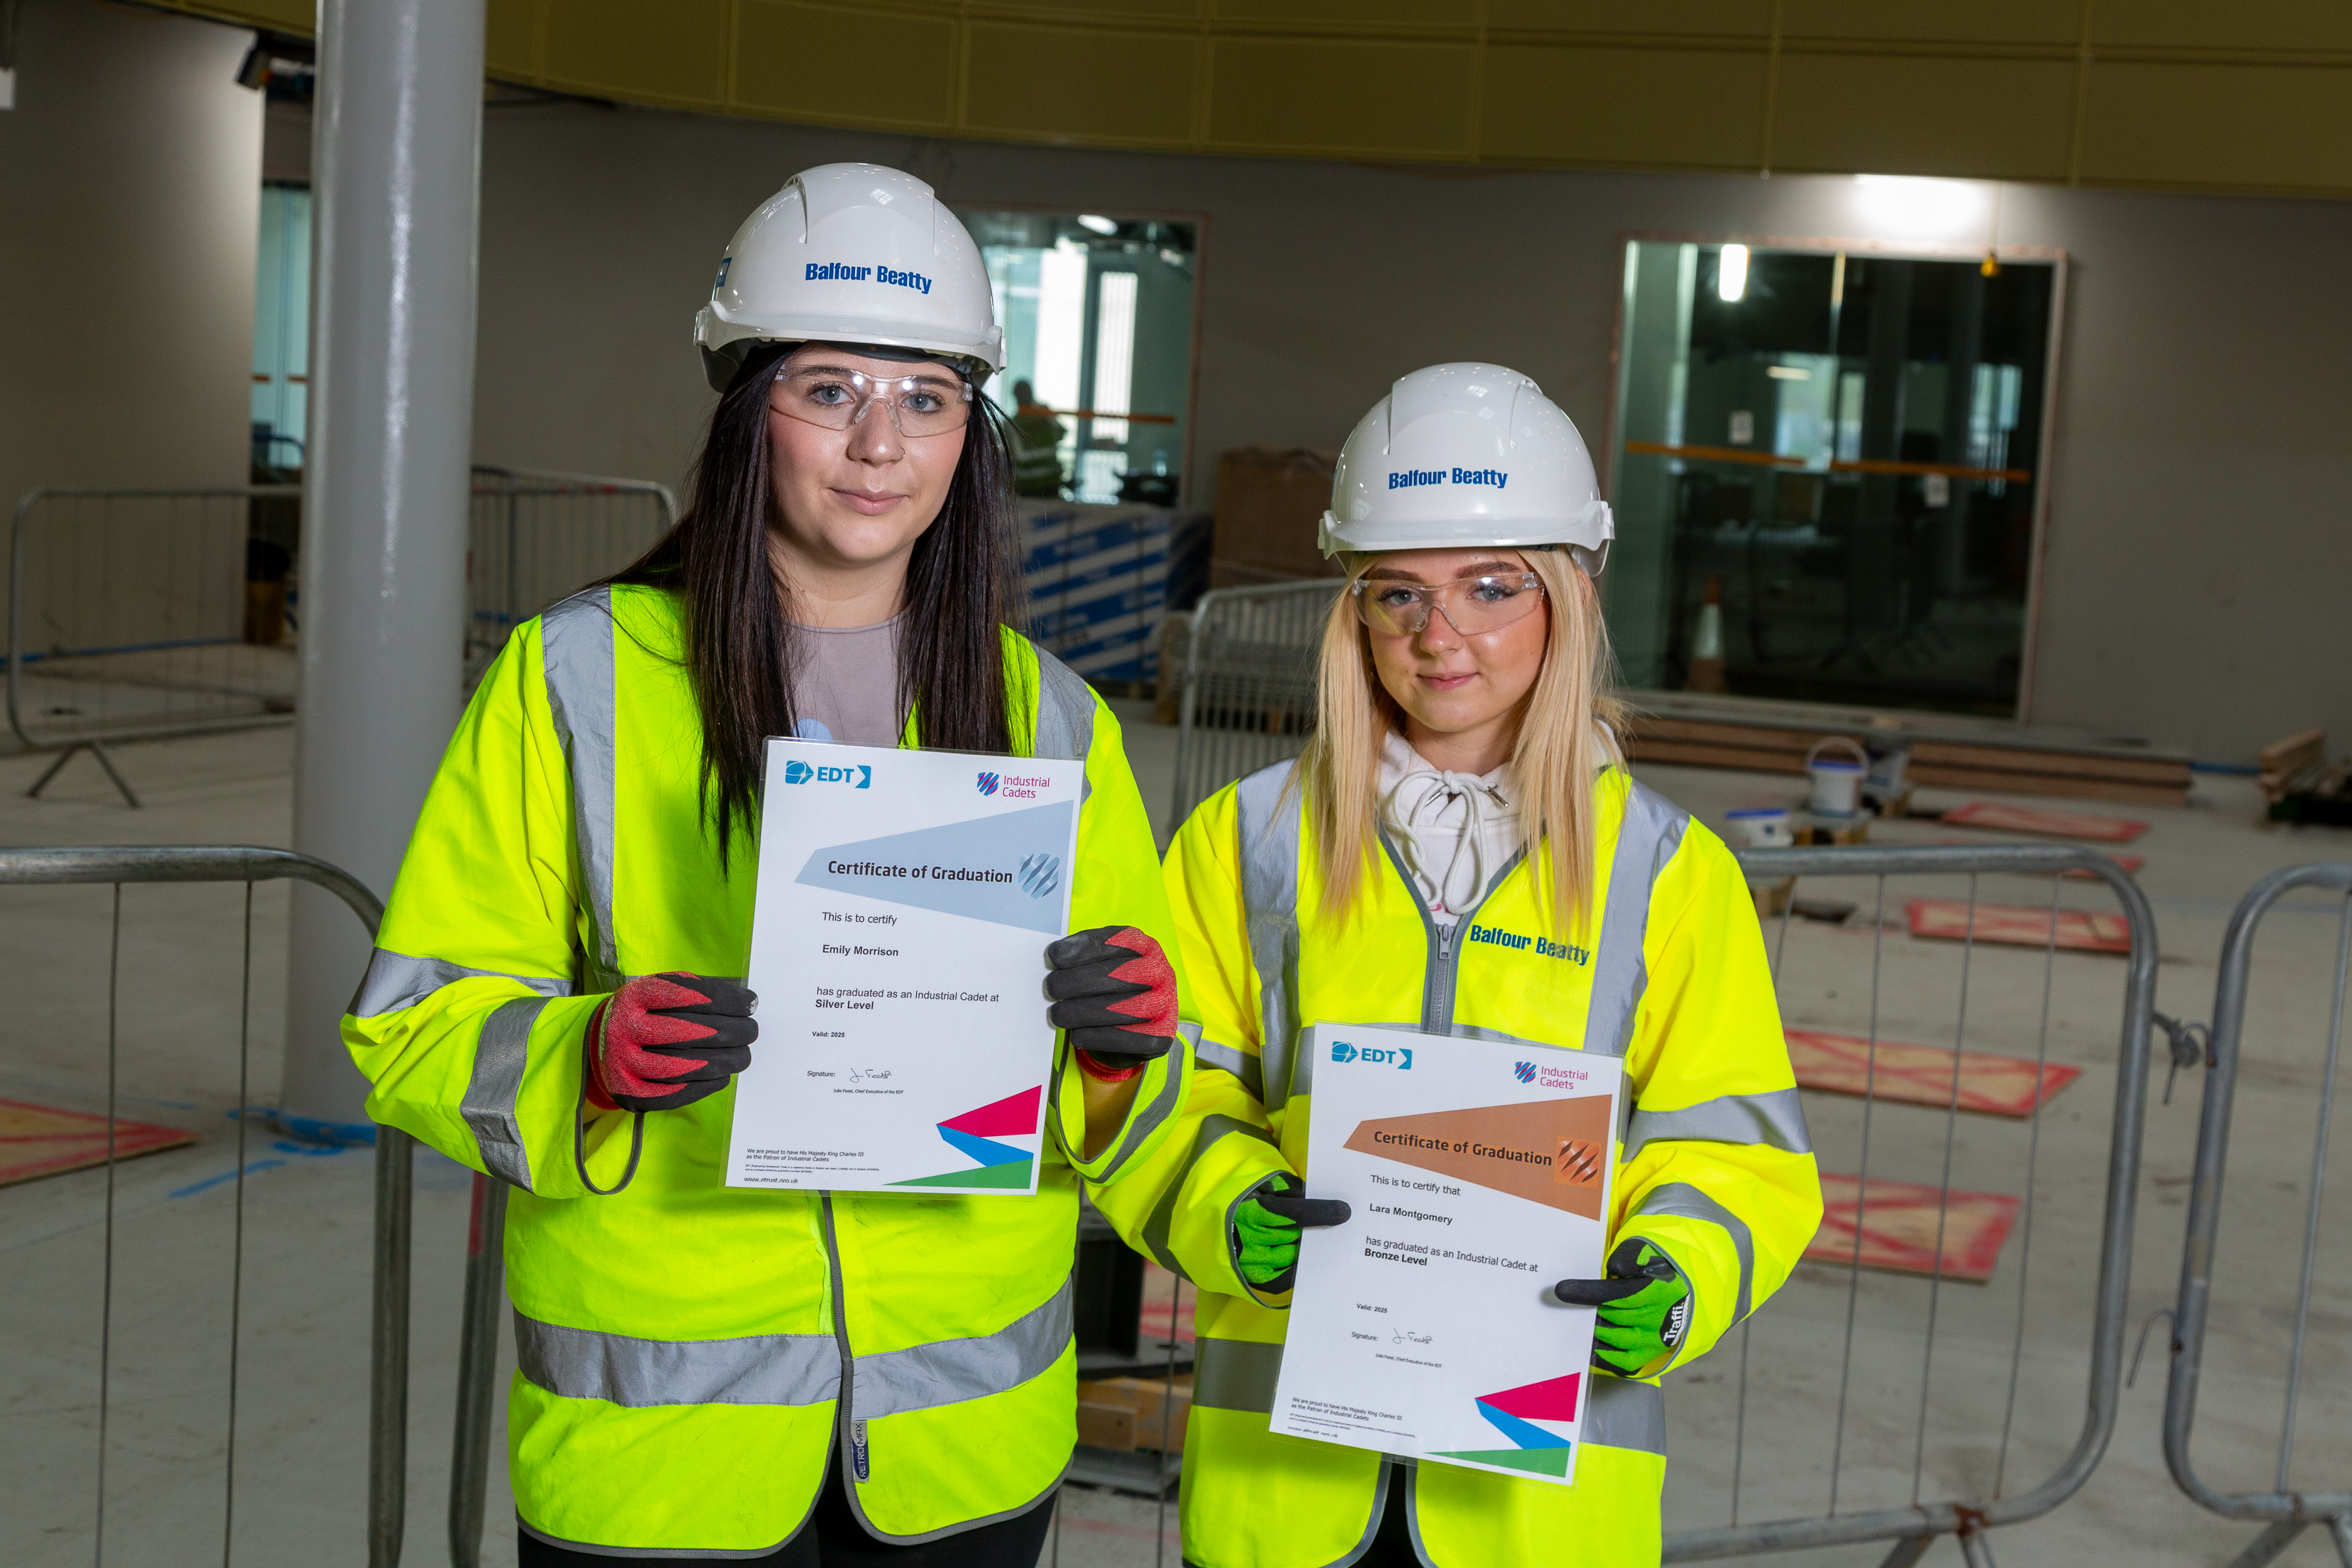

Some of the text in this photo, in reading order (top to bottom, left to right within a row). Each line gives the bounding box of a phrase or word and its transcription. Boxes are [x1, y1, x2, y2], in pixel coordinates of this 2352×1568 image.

[804, 261, 932, 295] Balfour Beatty
[1388, 467, 1508, 490] Balfour Beatty
[817, 767, 854, 783] EDT
[1004, 775, 1050, 787] Industrial
[1003, 787, 1036, 799] Cadets
[828, 861, 1012, 883] Certificate of Graduation
[822, 912, 897, 926] This is to certify
[822, 944, 899, 956] Emily Morrison
[1469, 924, 1591, 966] Balfour Beatty
[817, 987, 834, 996] has
[836, 988, 884, 998] graduated
[915, 990, 957, 1000] Industrial
[960, 992, 988, 1002] Cadet
[815, 999, 874, 1010] Silver Level
[1361, 1048, 1396, 1063] EDT
[1540, 1066, 1588, 1082] Industrial
[1540, 1077, 1574, 1090] Cadets
[1374, 1131, 1552, 1166] Certificate of Graduation
[1371, 1175, 1389, 1185] This
[1392, 1177, 1399, 1186] is
[1413, 1183, 1440, 1194] certify
[1442, 1185, 1461, 1196] that
[1370, 1204, 1453, 1225] Lara Montgomery
[1365, 1248, 1427, 1266] Bronze Level
[1366, 1236, 1381, 1246] has
[1384, 1241, 1428, 1254] graduated
[1456, 1251, 1498, 1265] Industrial
[1501, 1258, 1527, 1270] Cadet
[1529, 1264, 1538, 1273] at
[1351, 1331, 1379, 1341] Signature:
